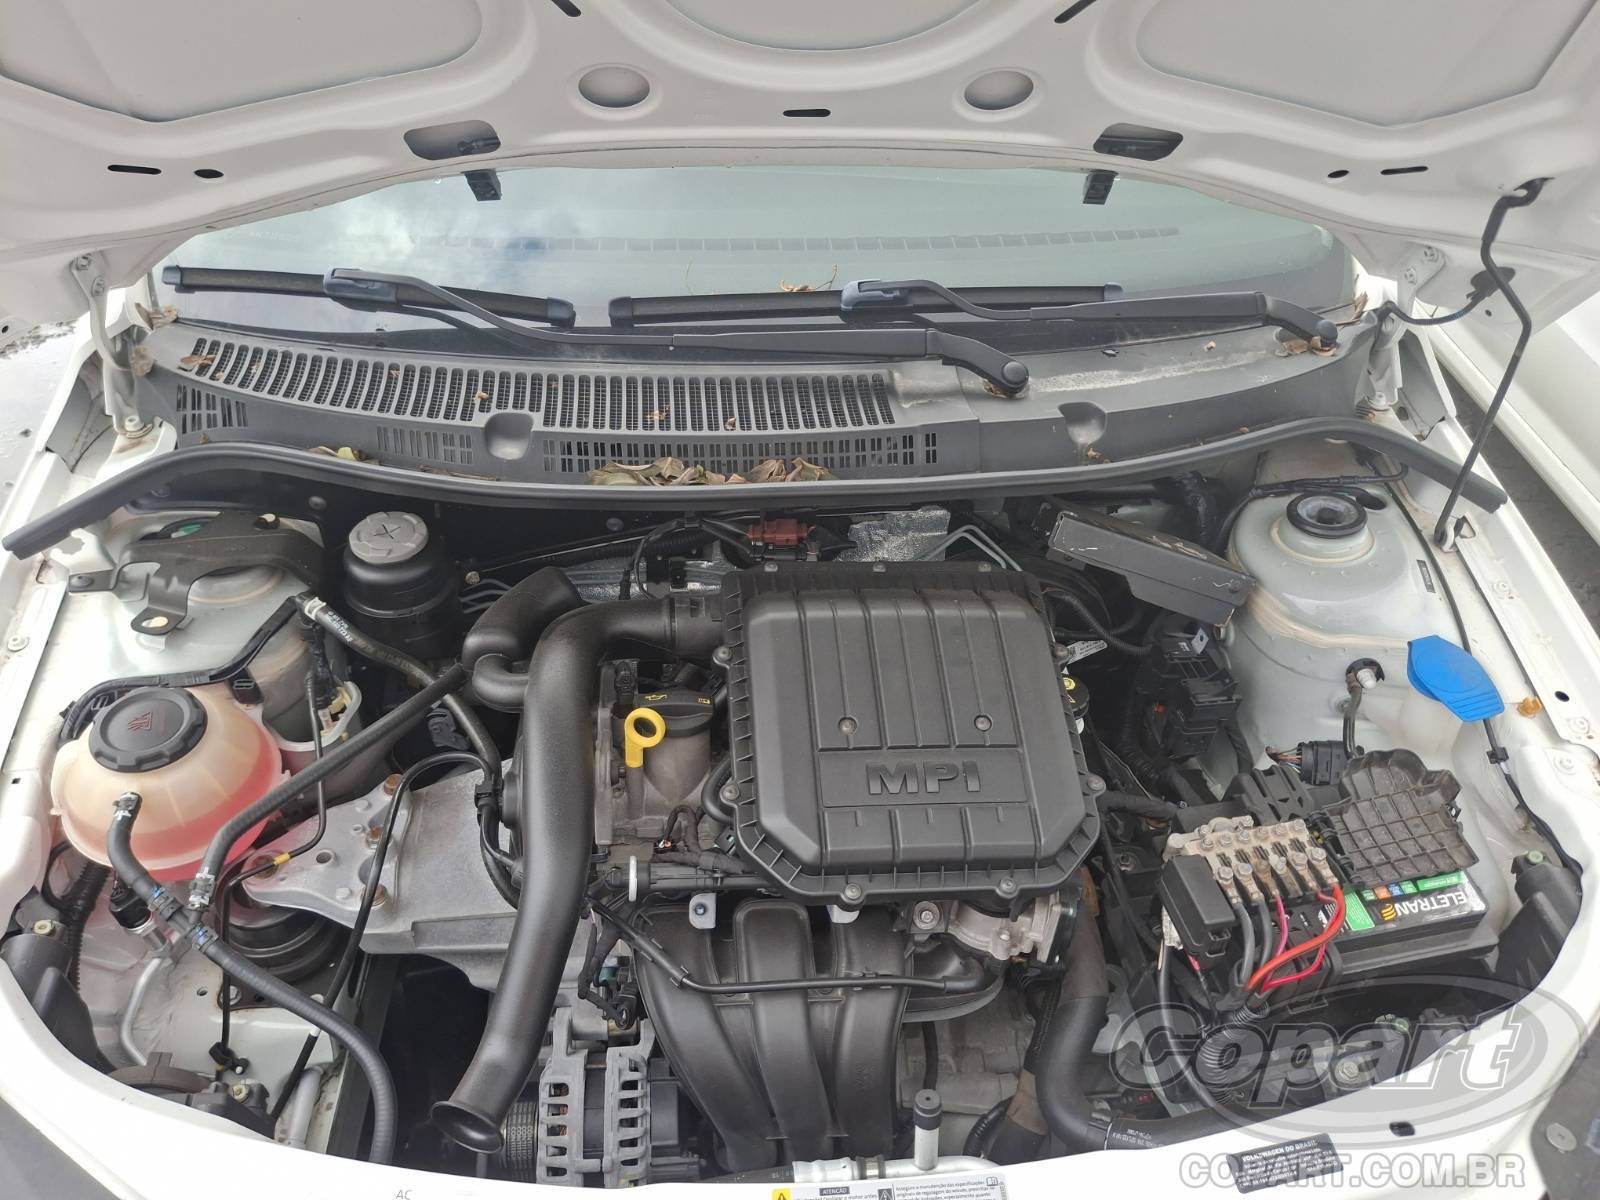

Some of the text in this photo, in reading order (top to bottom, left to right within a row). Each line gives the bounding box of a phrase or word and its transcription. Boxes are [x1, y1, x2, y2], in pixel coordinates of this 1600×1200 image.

[866, 761, 982, 795] MPI
[1395, 891, 1468, 916] ELETRAN
[1242, 1149, 1285, 1162] VOLKSWAGEN
[1295, 1140, 1317, 1150] BRASIL
